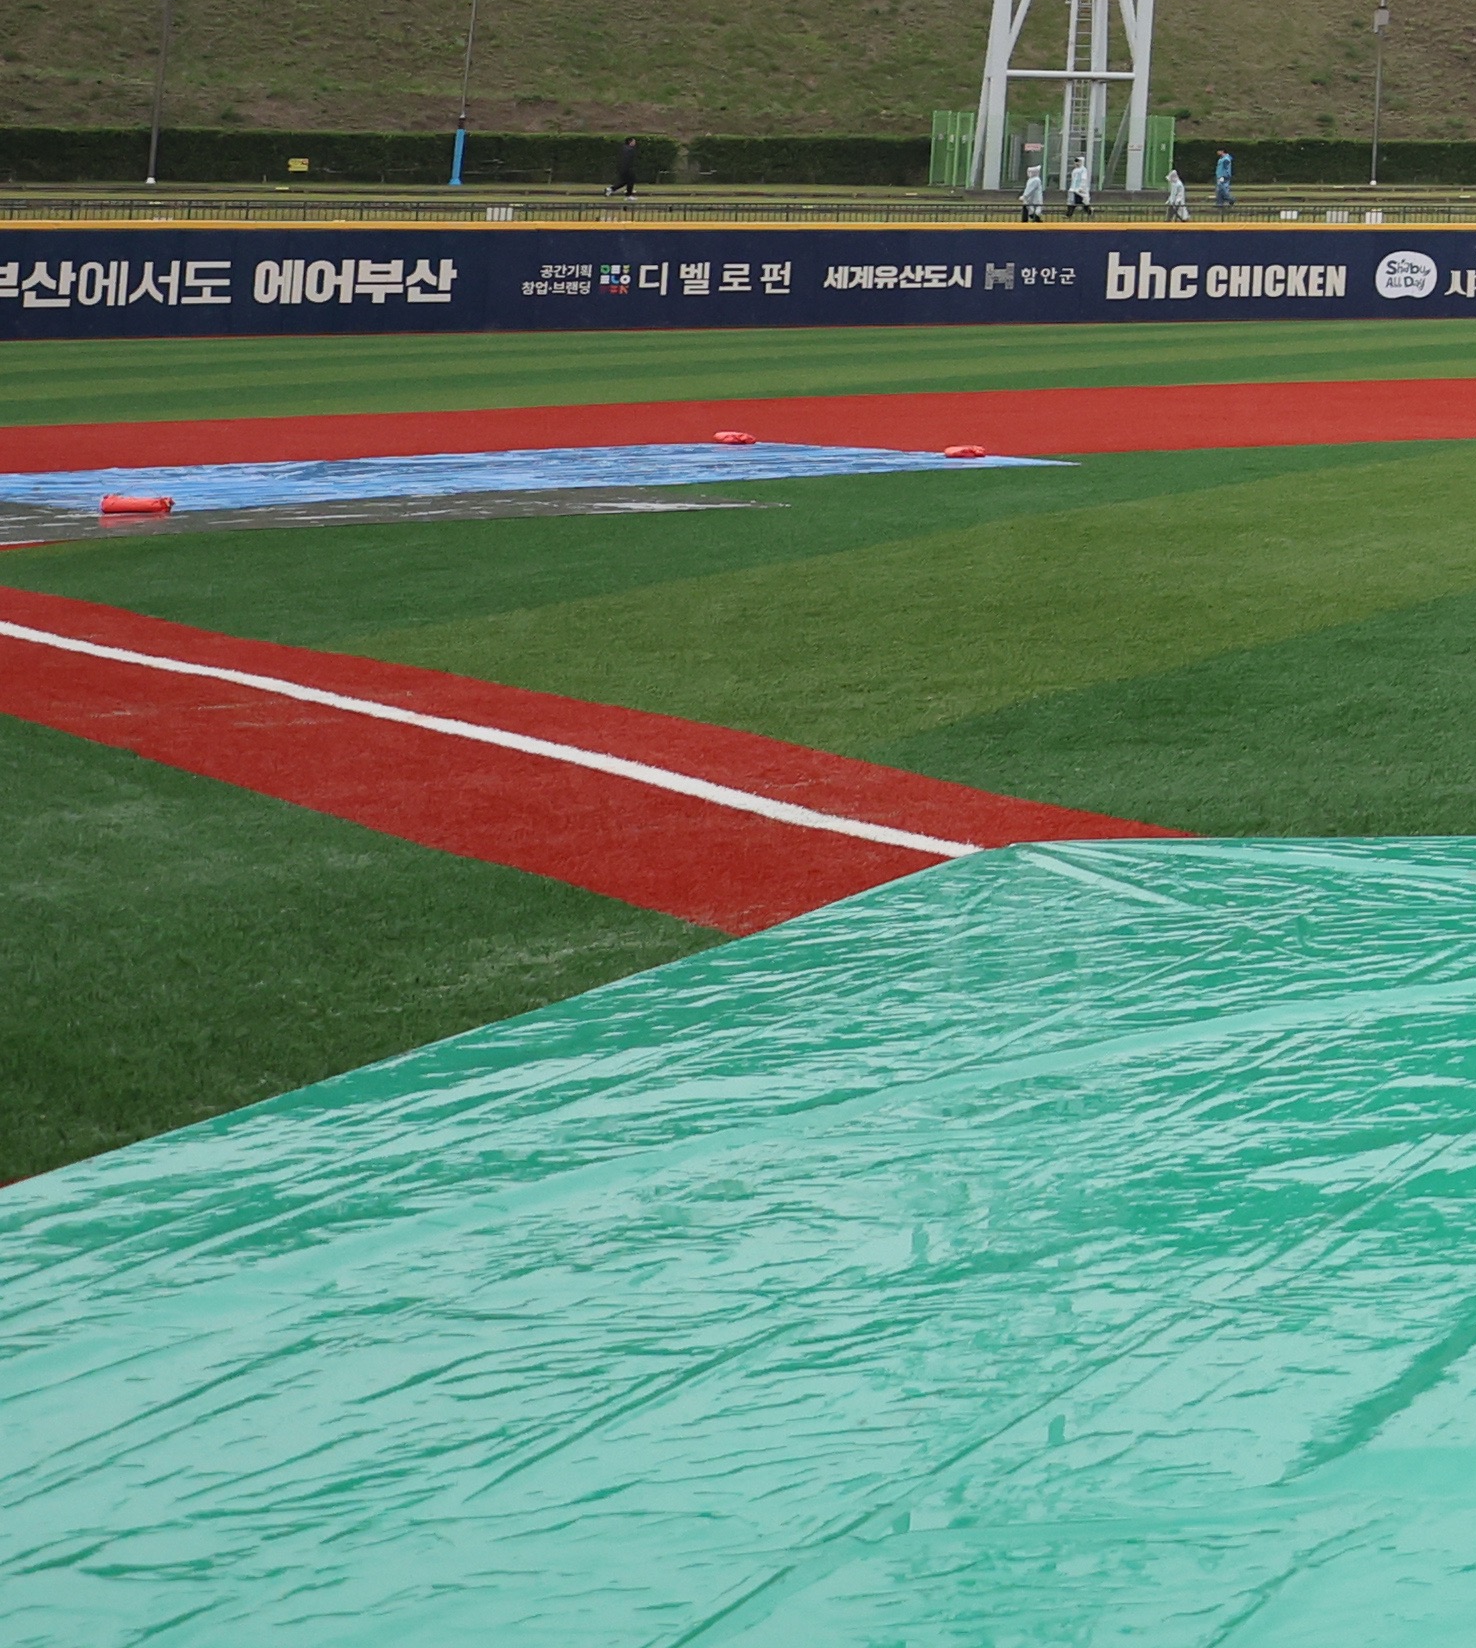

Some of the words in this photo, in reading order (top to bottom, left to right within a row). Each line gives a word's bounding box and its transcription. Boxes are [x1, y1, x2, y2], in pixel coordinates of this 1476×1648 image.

[253, 258, 458, 304] 에어부산
[539, 263, 593, 279] 공간기획
[823, 264, 973, 289] 세계유산도시
[1020, 266, 1076, 285] 함안군
[1106, 251, 1199, 300] bhc
[1206, 264, 1347, 298] CHICKEN
